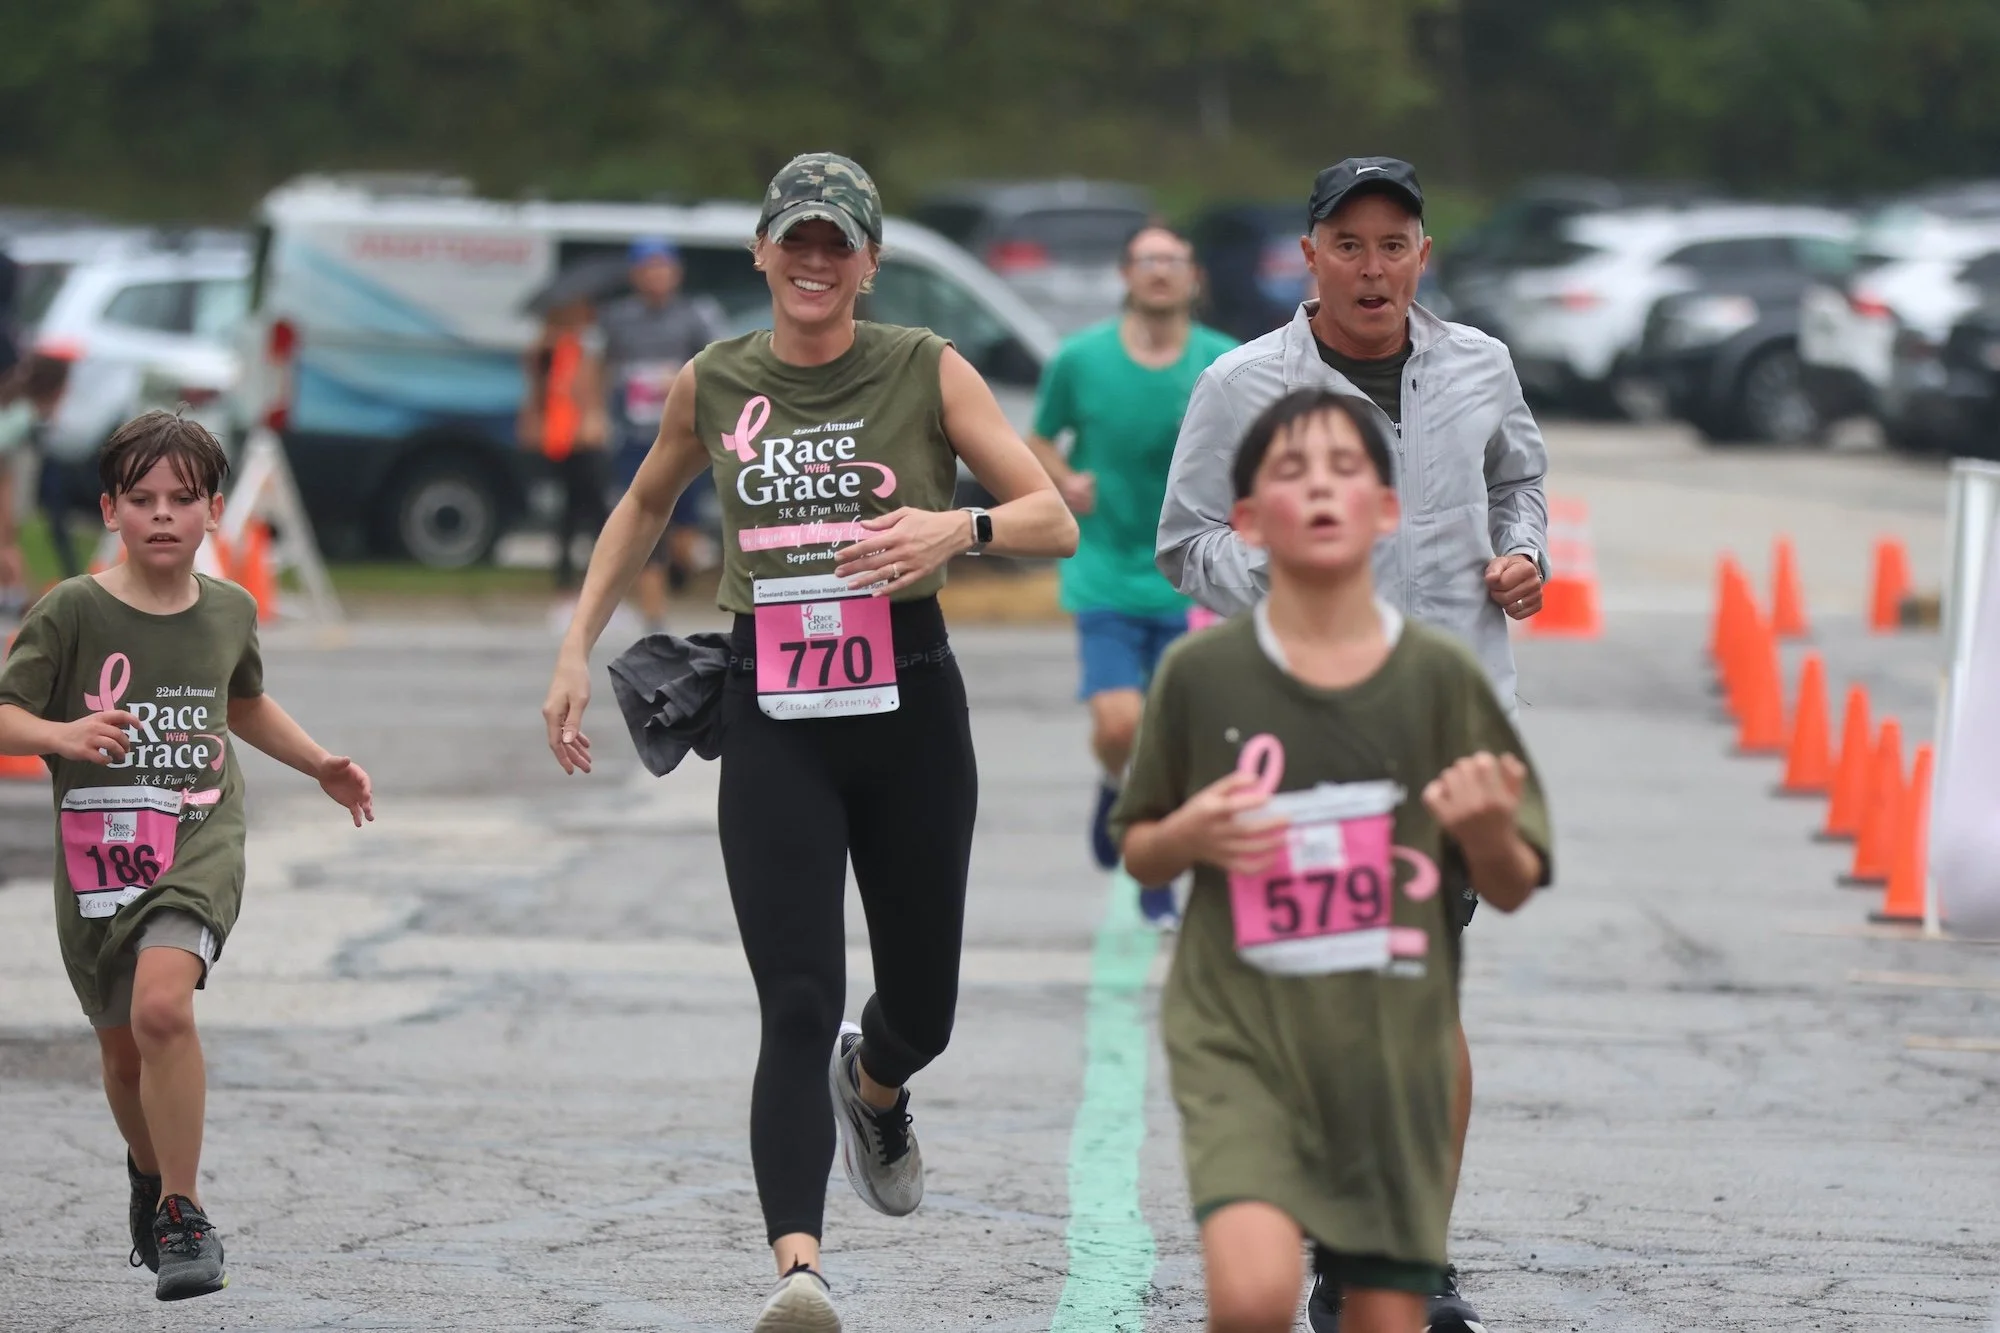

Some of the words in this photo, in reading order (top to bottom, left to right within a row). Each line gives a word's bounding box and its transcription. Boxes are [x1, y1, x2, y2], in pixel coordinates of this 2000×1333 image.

[792, 425, 821, 435] 22nd
[823, 418, 865, 432] Annual
[761, 436, 856, 479] Race
[804, 463, 831, 474] With
[737, 464, 861, 506] Grace
[778, 508, 793, 519] 5K
[797, 506, 807, 517] &
[810, 505, 831, 516] Fun
[834, 502, 861, 513] Walk
[786, 549, 838, 564] Septemb
[758, 591, 783, 599] Cleveland
[800, 588, 821, 596] Medina
[822, 586, 846, 595] Hospital
[808, 620, 834, 630] Grace
[813, 614, 833, 625] Race
[780, 636, 872, 689] 770
[156, 685, 182, 698] 22nd
[184, 685, 217, 698] Annual
[126, 702, 208, 743] Race
[165, 732, 189, 742] With
[134, 774, 150, 786] 5K
[152, 774, 161, 786] &
[163, 774, 183, 786] Fun
[144, 797, 163, 806] Medical
[163, 801, 177, 809] Staff
[108, 829, 130, 838] Grace
[113, 822, 130, 832] Race
[86, 844, 160, 887] 186
[1265, 866, 1383, 935] 579
